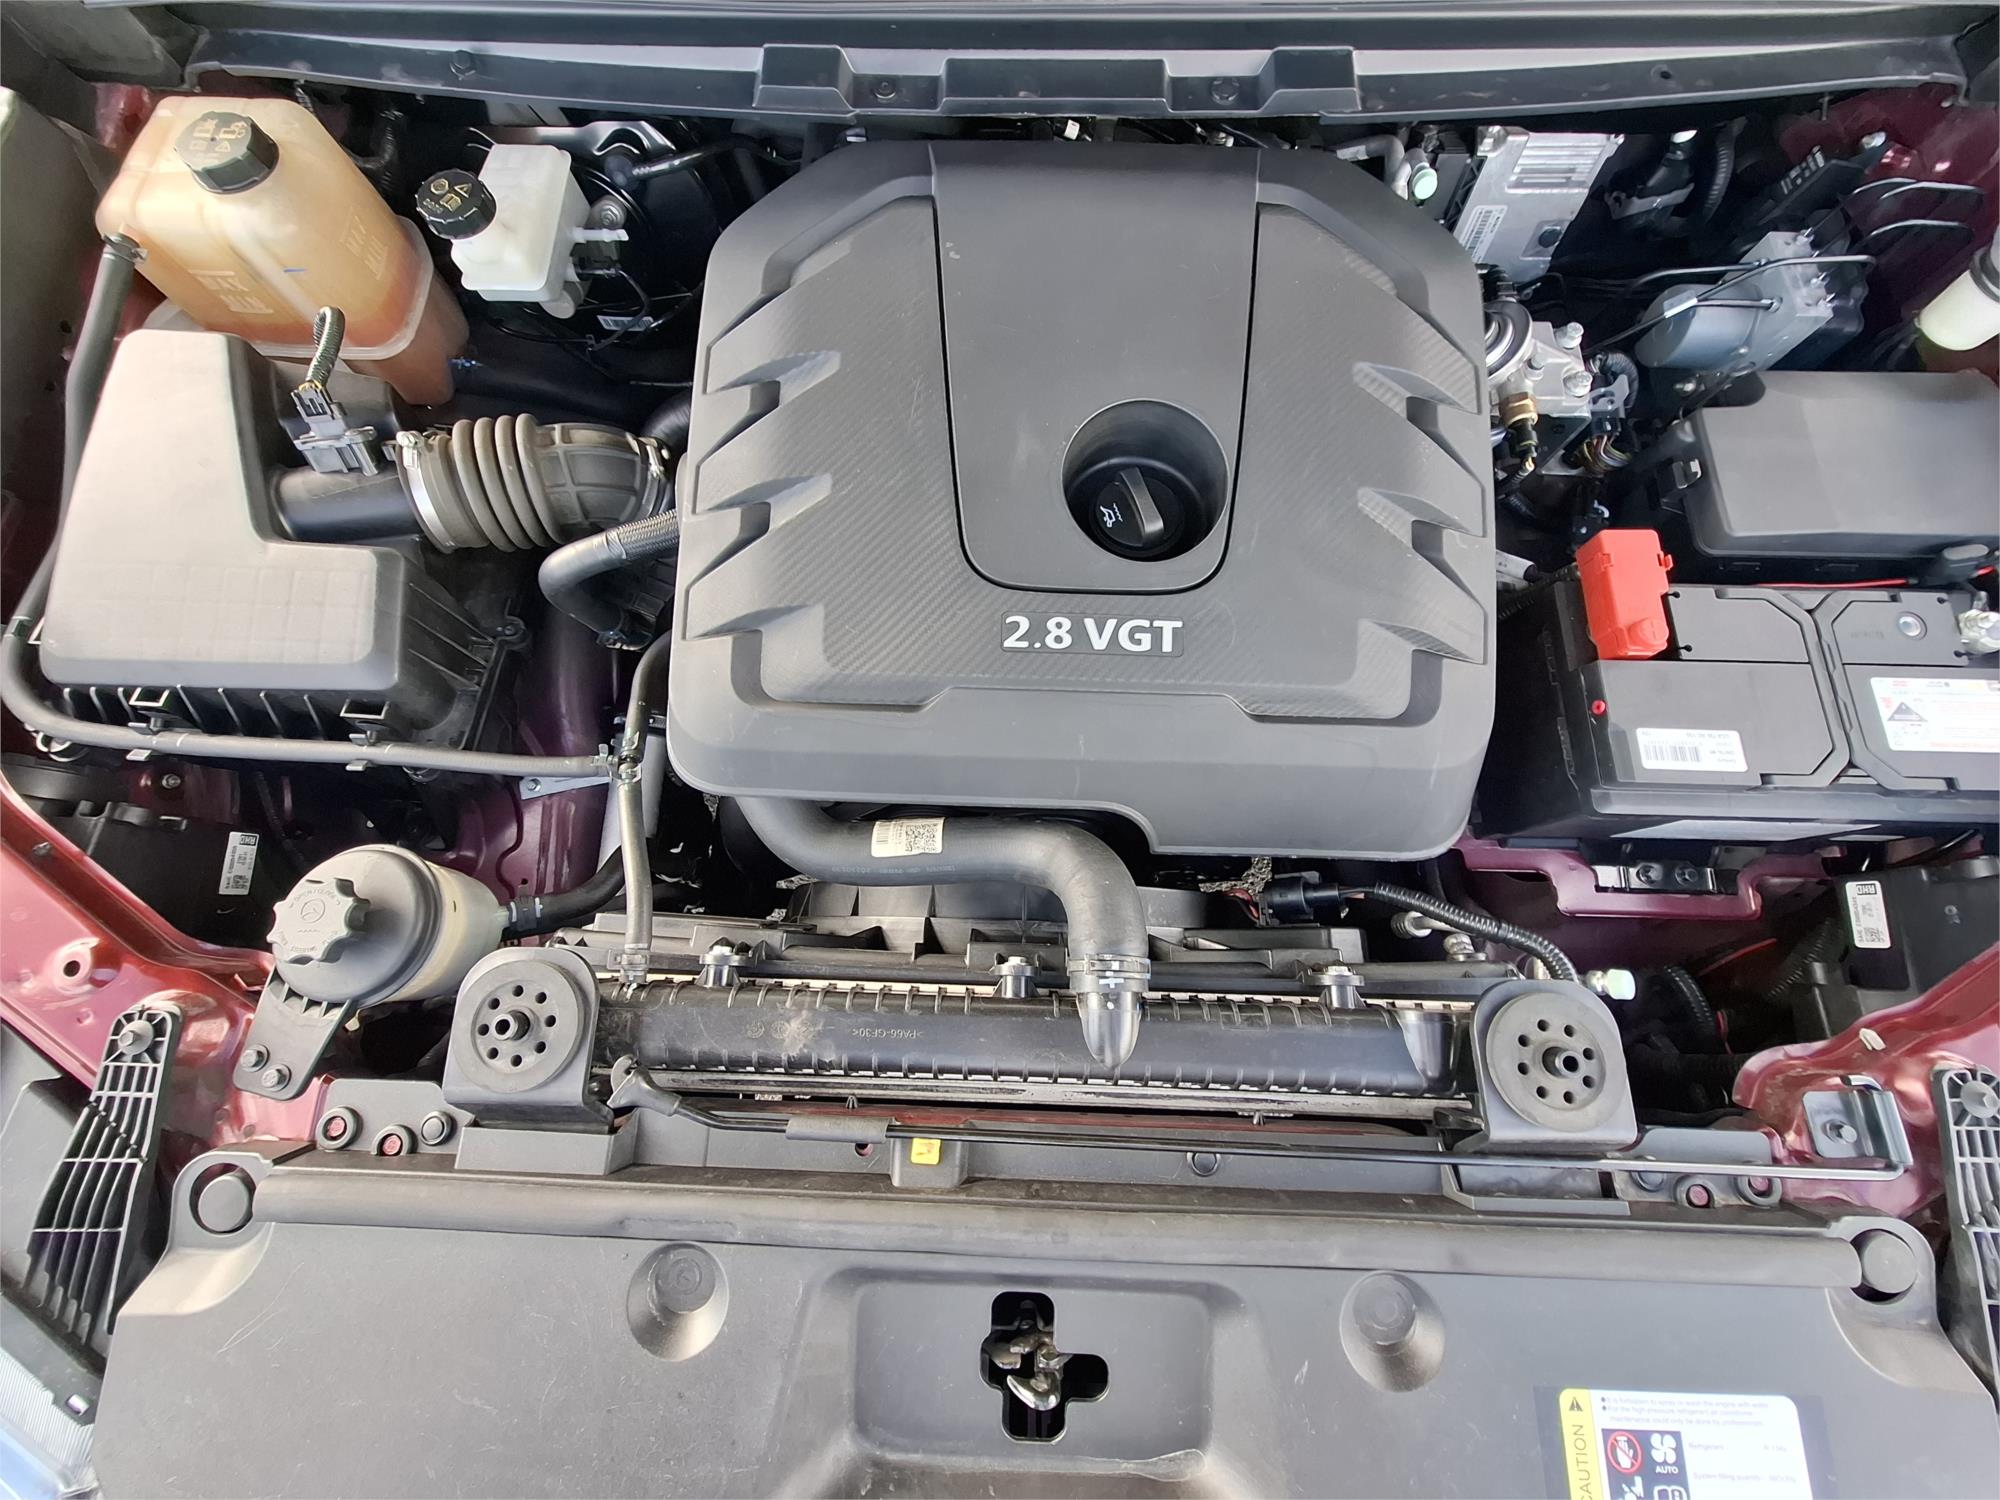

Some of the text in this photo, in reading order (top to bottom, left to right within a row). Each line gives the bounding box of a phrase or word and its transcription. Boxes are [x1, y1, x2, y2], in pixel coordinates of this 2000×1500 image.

[1003, 615, 1184, 653] 2.8 VGT
[1857, 885, 1876, 895] RHD
[1655, 1465, 1679, 1474] AUTO
